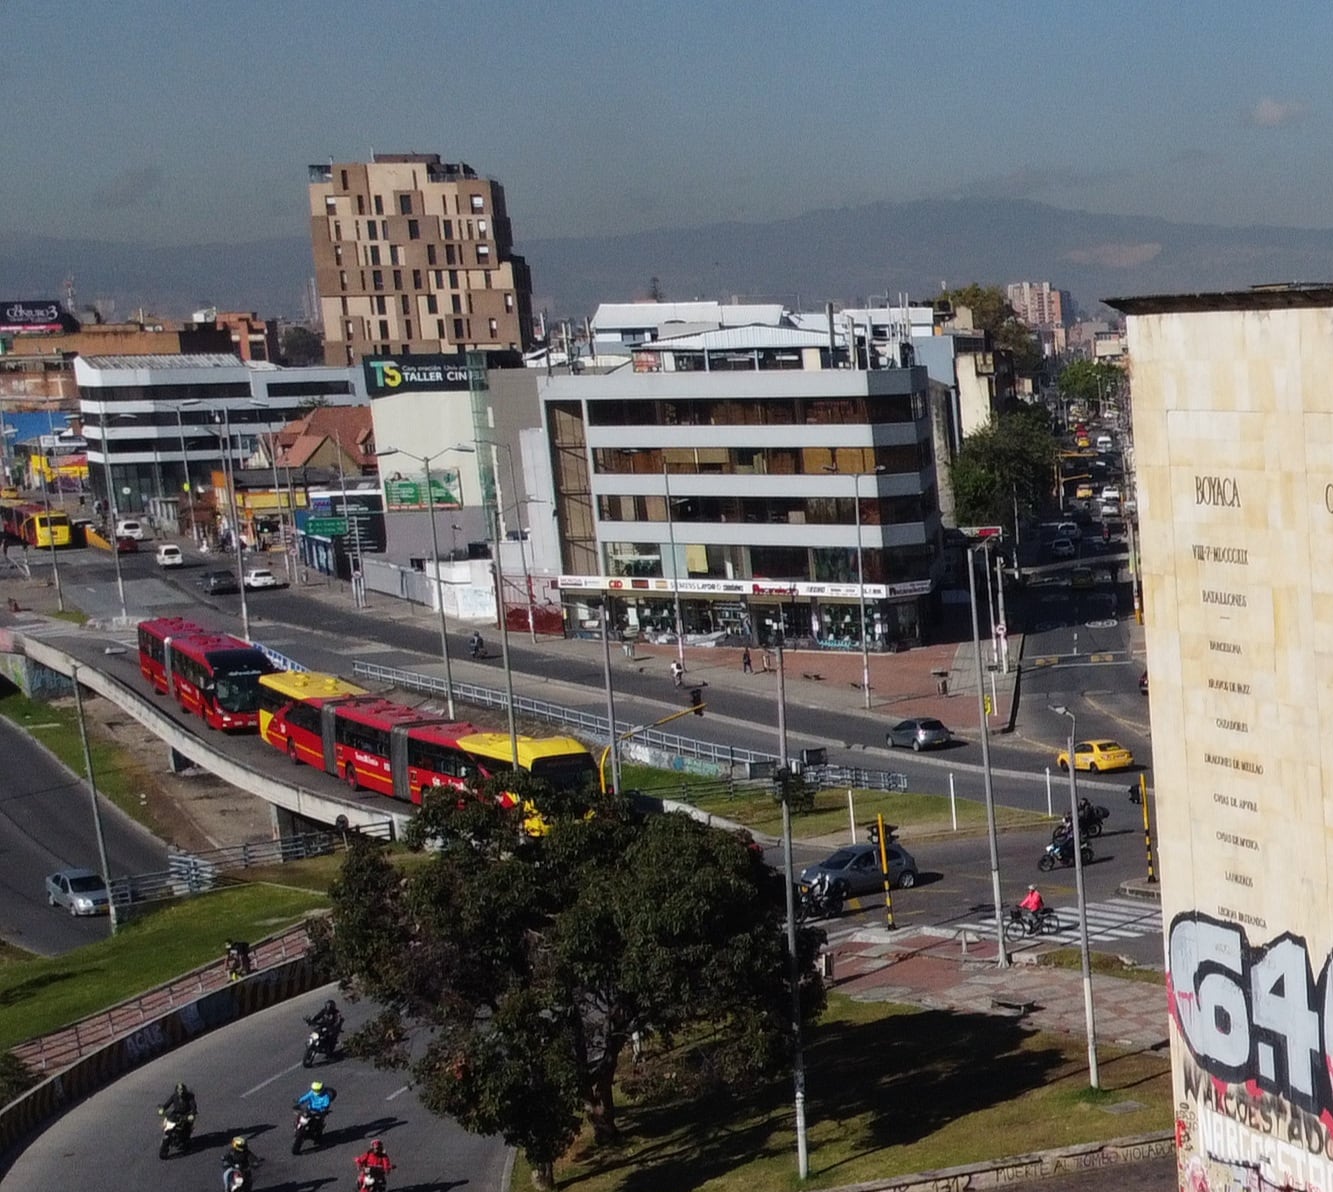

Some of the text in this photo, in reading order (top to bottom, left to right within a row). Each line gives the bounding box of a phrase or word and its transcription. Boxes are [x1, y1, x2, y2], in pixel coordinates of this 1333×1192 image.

[402, 371, 443, 382] TALLER
[1195, 476, 1241, 507] BOYACA
[1202, 590, 1247, 608] BATALLONES
